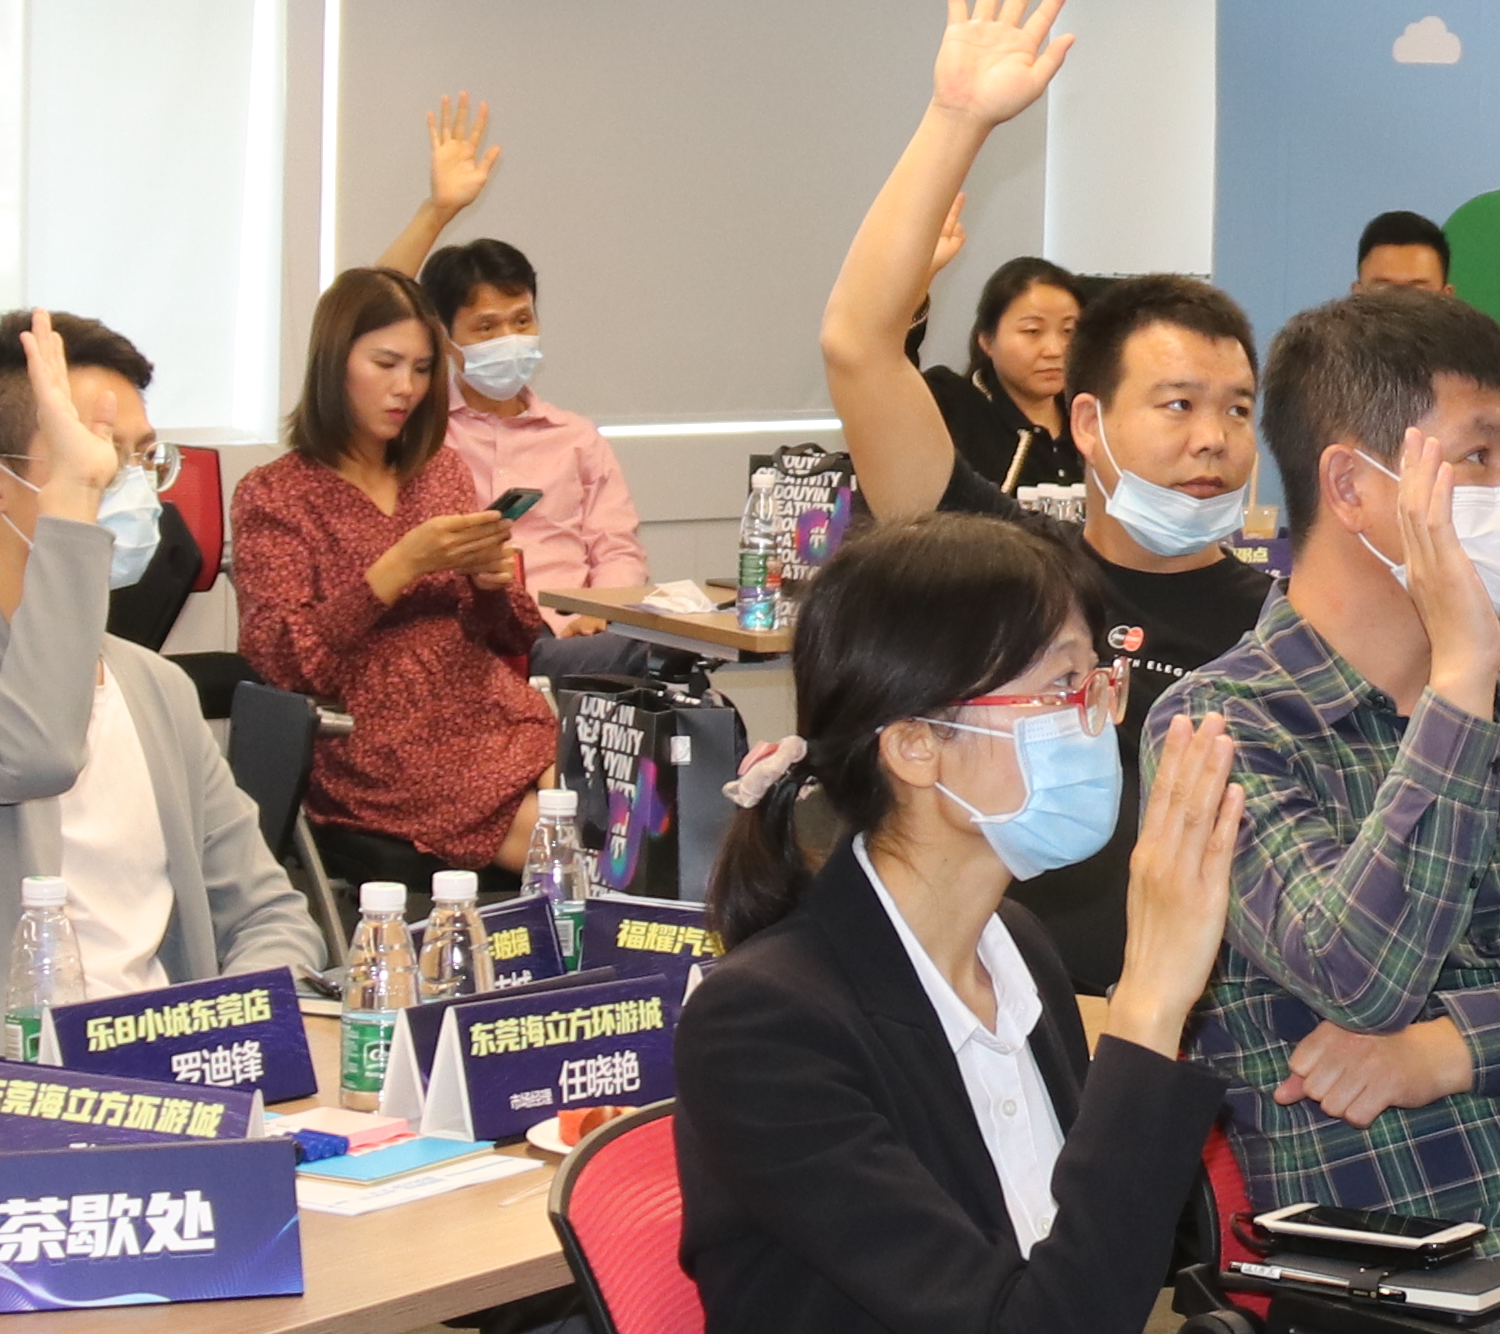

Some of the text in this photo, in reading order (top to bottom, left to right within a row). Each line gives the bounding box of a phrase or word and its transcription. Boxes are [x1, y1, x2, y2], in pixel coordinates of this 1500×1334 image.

[1146, 660, 1191, 678] ELEG
[468, 996, 664, 1058] 东莞海立方环游城
[171, 1039, 265, 1087] 罗迪锋
[558, 1049, 641, 1105] 任晓艳
